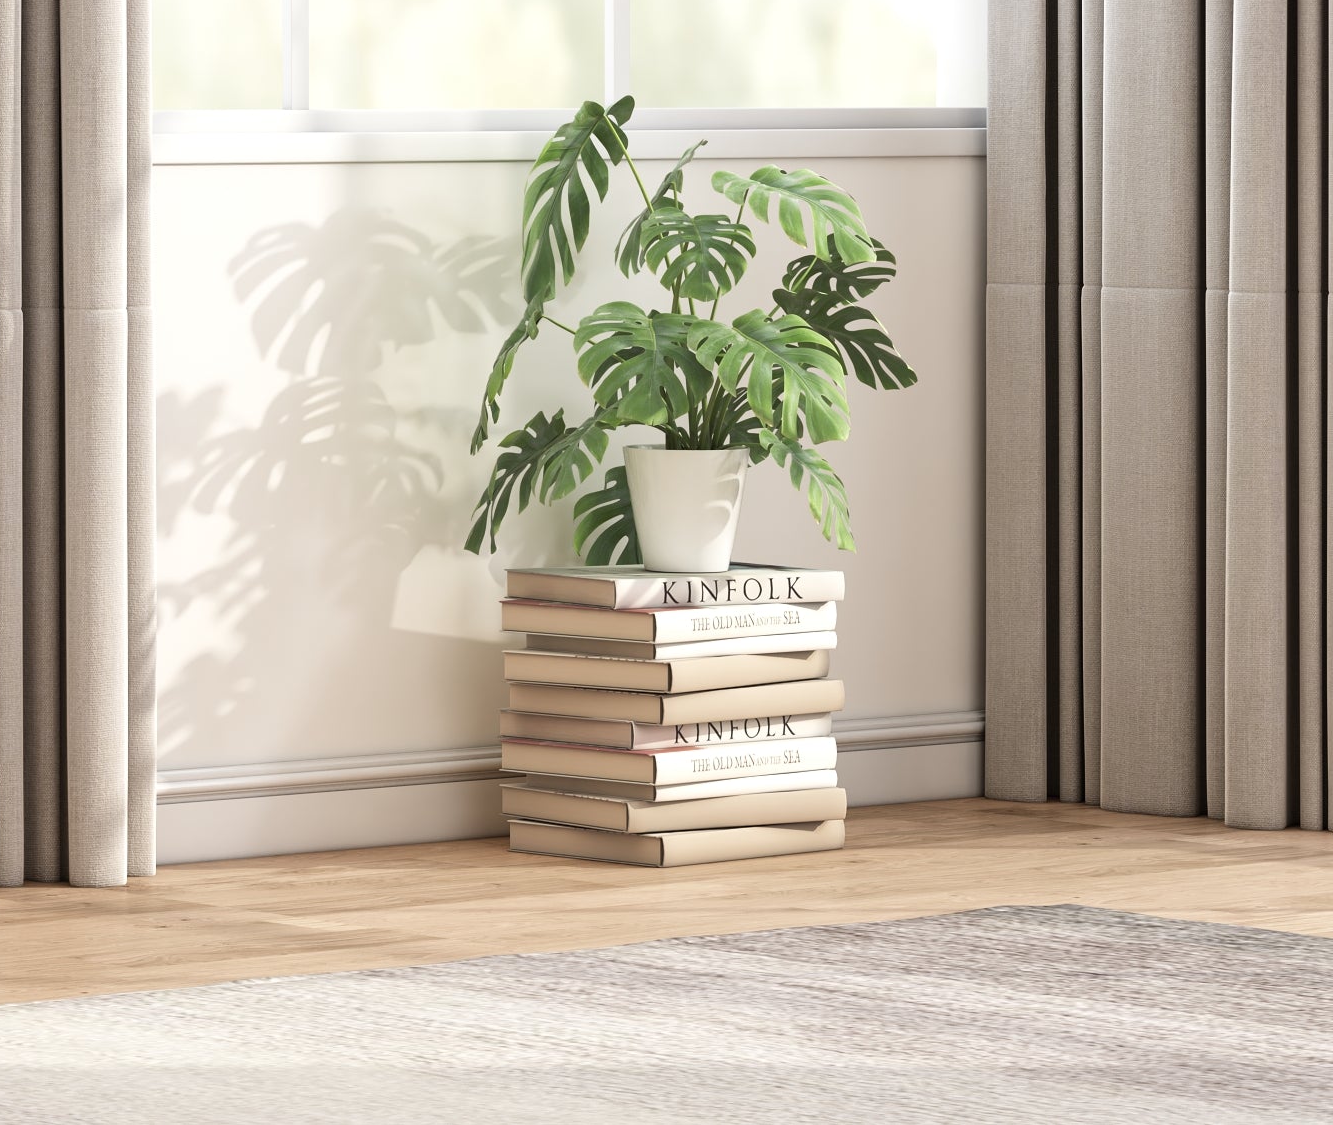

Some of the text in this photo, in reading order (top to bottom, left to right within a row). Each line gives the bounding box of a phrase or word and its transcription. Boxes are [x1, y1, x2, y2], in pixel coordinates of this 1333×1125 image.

[662, 576, 803, 604] KINFOLK
[690, 618, 711, 632] THE
[712, 616, 733, 630] OLD
[734, 613, 756, 628] MAN
[783, 610, 801, 625] SEA
[674, 715, 796, 744] KINFOLK
[690, 758, 711, 773] THE
[712, 756, 733, 771] OLD
[734, 753, 756, 769] MAN
[783, 749, 801, 764] SEA
